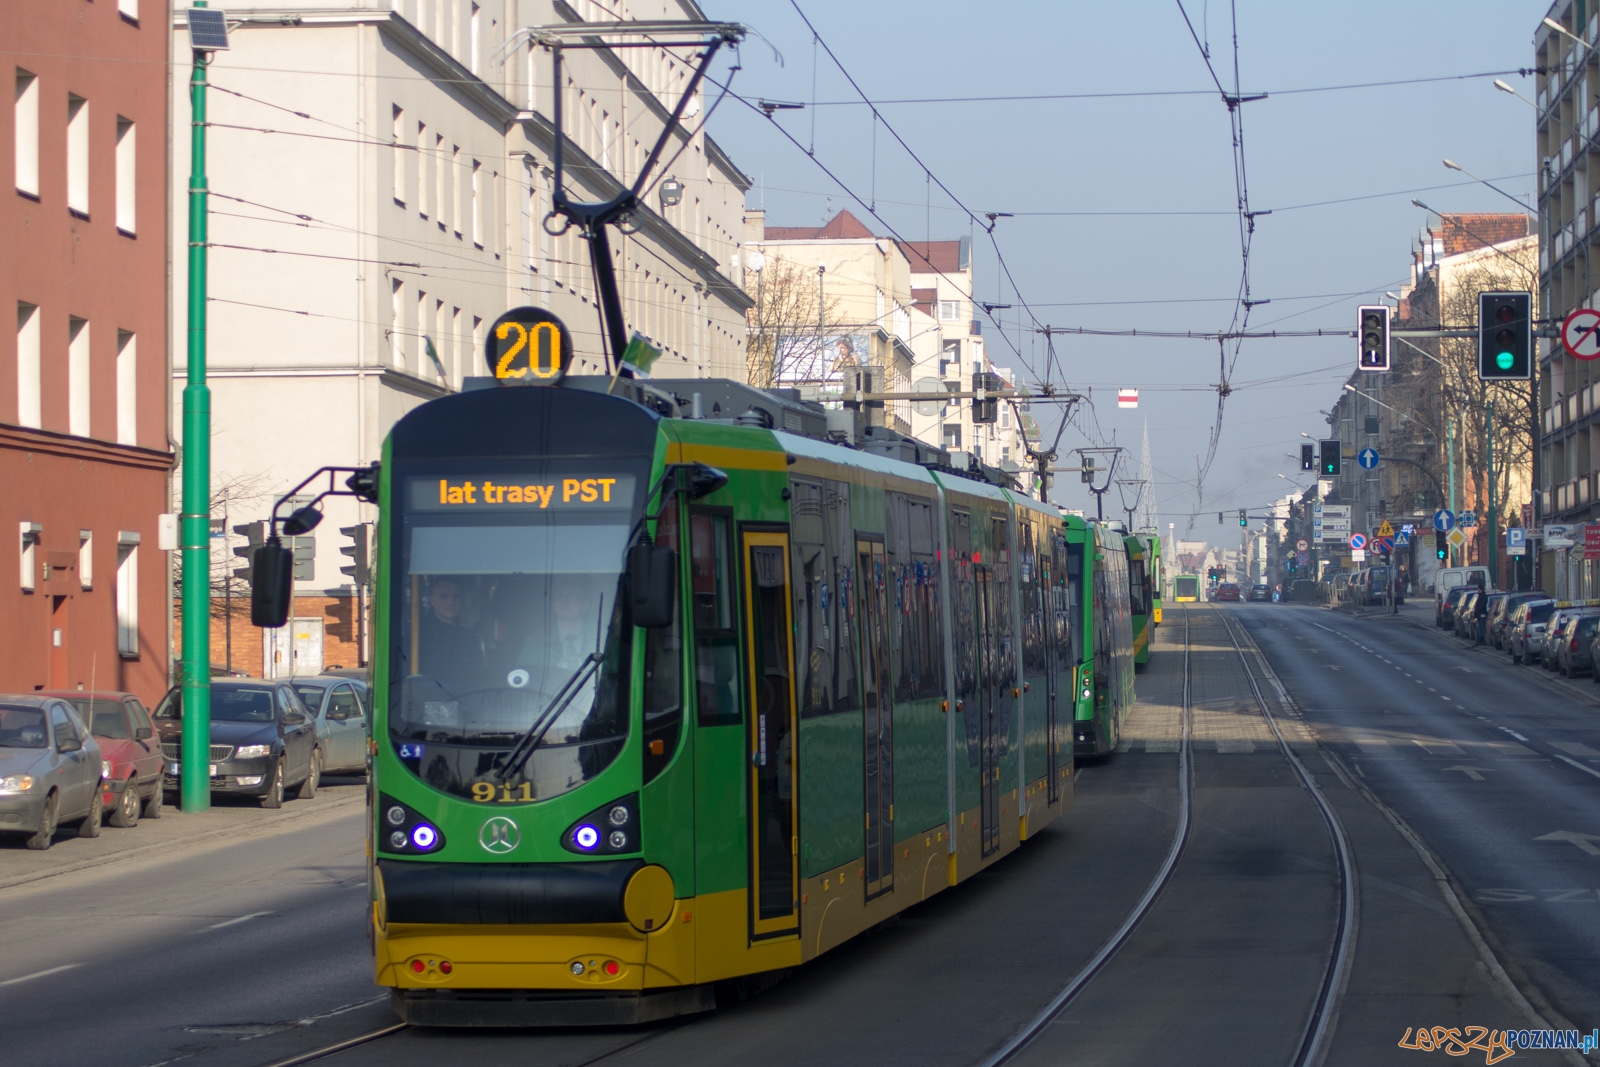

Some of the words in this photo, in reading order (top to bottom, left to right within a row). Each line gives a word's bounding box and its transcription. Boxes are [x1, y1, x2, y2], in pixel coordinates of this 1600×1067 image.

[496, 321, 561, 379] 20
[439, 479, 476, 504] lat
[482, 480, 554, 508] trasy
[562, 478, 616, 502] PST
[811, 687, 822, 705] 911
[471, 781, 536, 803] 911
[1475, 888, 1600, 902] SZ
